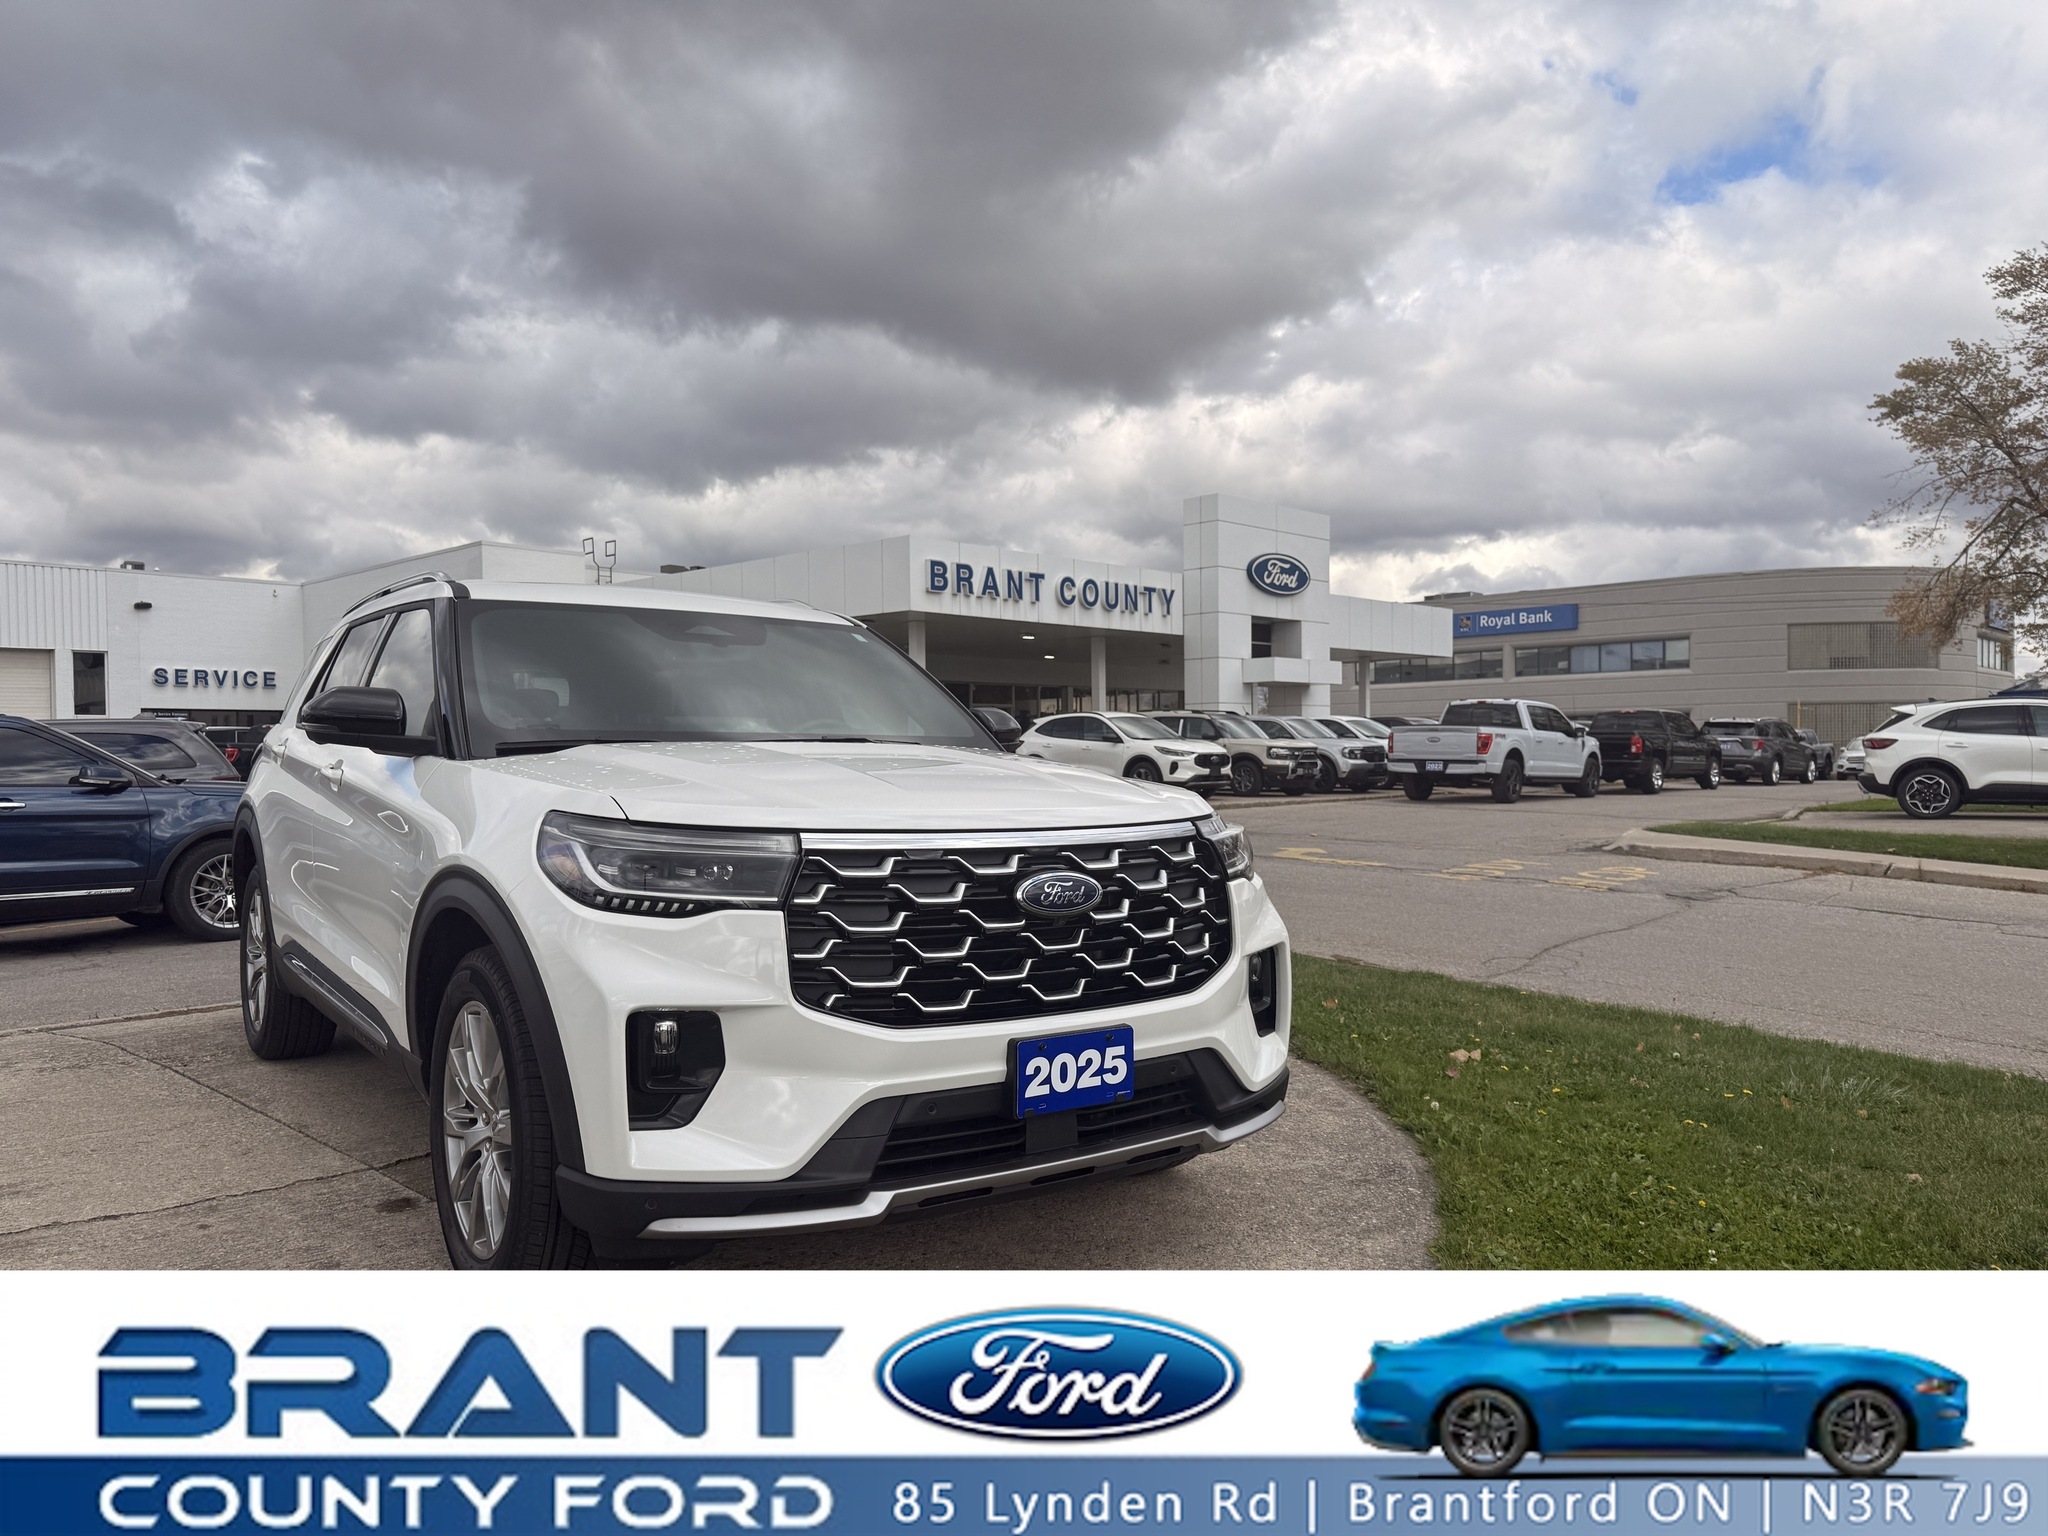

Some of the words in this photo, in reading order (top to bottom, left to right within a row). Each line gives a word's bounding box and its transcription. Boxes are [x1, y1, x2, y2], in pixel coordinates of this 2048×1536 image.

[1263, 559, 1299, 588] Ford
[925, 559, 1045, 604] BRANT
[1056, 575, 1175, 617] COUNTY
[1480, 612, 1515, 629] Royal
[1519, 609, 1552, 624] Bank
[153, 667, 277, 688] SERVICE
[1041, 881, 1086, 905] Ford
[1024, 1045, 1128, 1098] 2025
